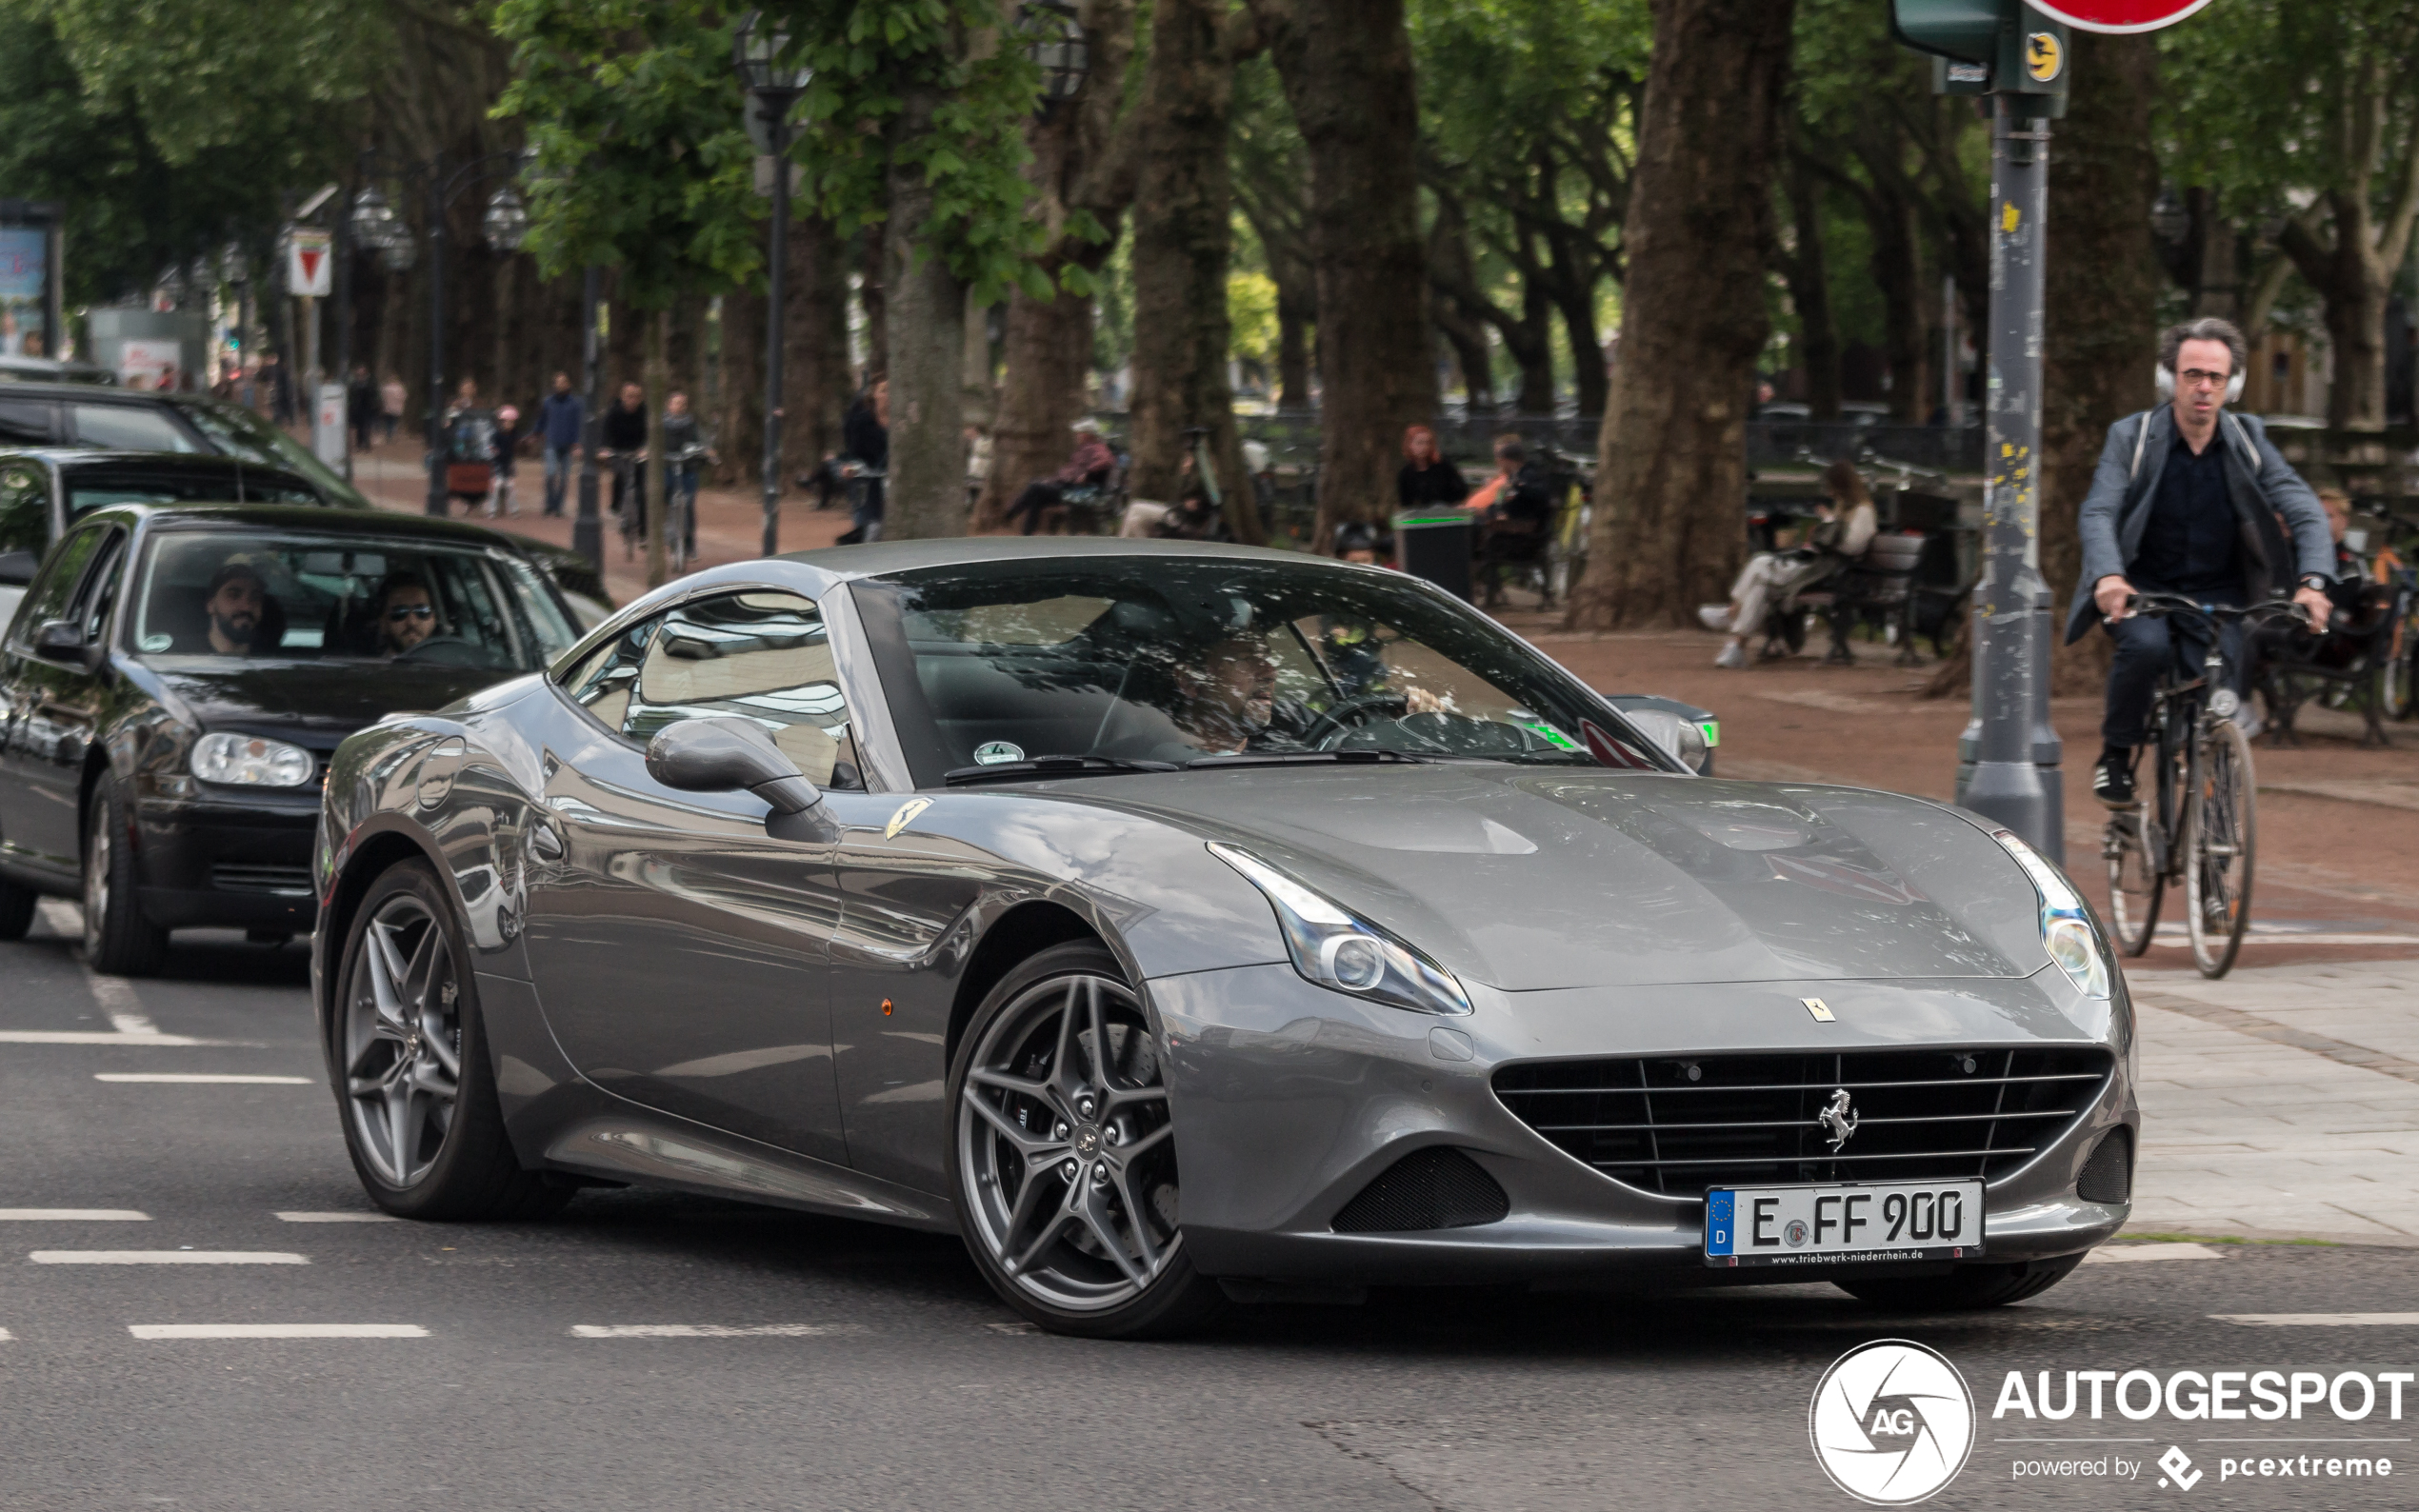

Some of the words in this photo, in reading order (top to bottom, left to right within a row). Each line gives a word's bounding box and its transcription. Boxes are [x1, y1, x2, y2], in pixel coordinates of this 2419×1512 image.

[991, 743, 1006, 755] 4
[1752, 1197, 1780, 1245] E
[1814, 1194, 1872, 1244] FF
[1883, 1190, 1962, 1242] 900
[1715, 1229, 1726, 1244] D
[1771, 1249, 1924, 1264] www.triebwerk-niederrhein.de
